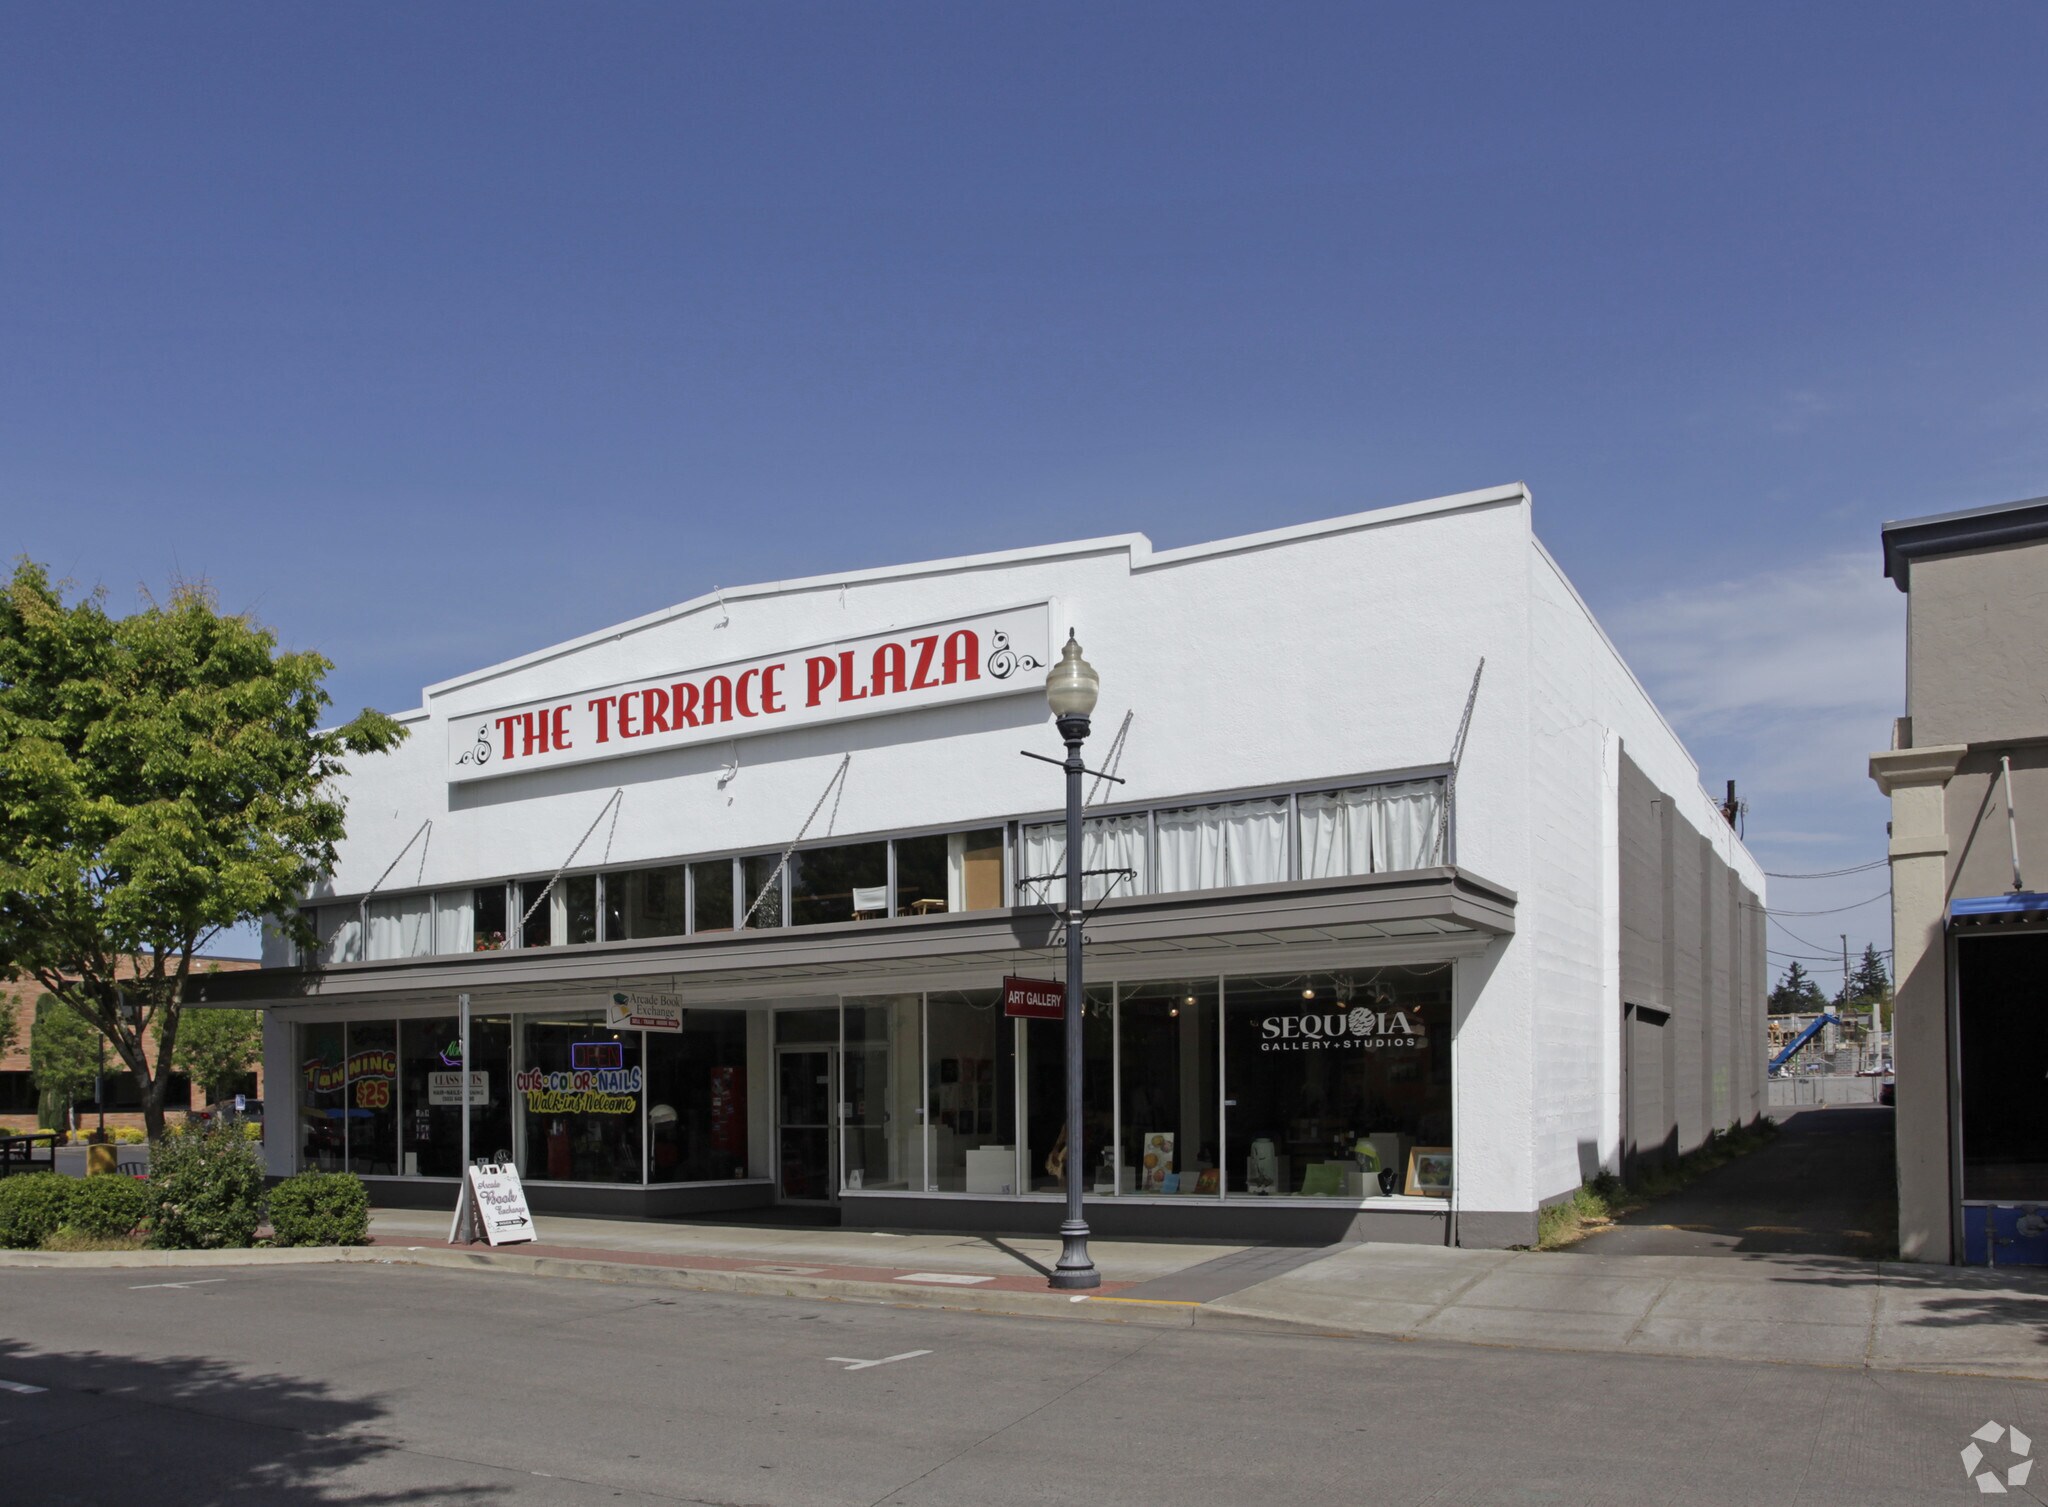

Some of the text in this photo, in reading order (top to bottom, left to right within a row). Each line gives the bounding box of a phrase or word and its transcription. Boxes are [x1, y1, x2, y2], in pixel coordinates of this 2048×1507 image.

[495, 629, 981, 760] THE TERRACE PLAZA
[630, 993, 680, 1007] Arcade Book
[1008, 991, 1061, 1007] ART GALLERY
[636, 1004, 674, 1019] Exchange
[1261, 1007, 1413, 1040] SEQUOIA
[575, 1045, 619, 1067] OPEN
[303, 1051, 397, 1091] TANNING
[435, 1074, 459, 1085] CLASS
[357, 1081, 389, 1108] $25
[583, 1091, 635, 1113] Welcome
[478, 1180, 500, 1189] Arcade
[480, 1189, 517, 1205] Book
[495, 1206, 525, 1215] Exchange
